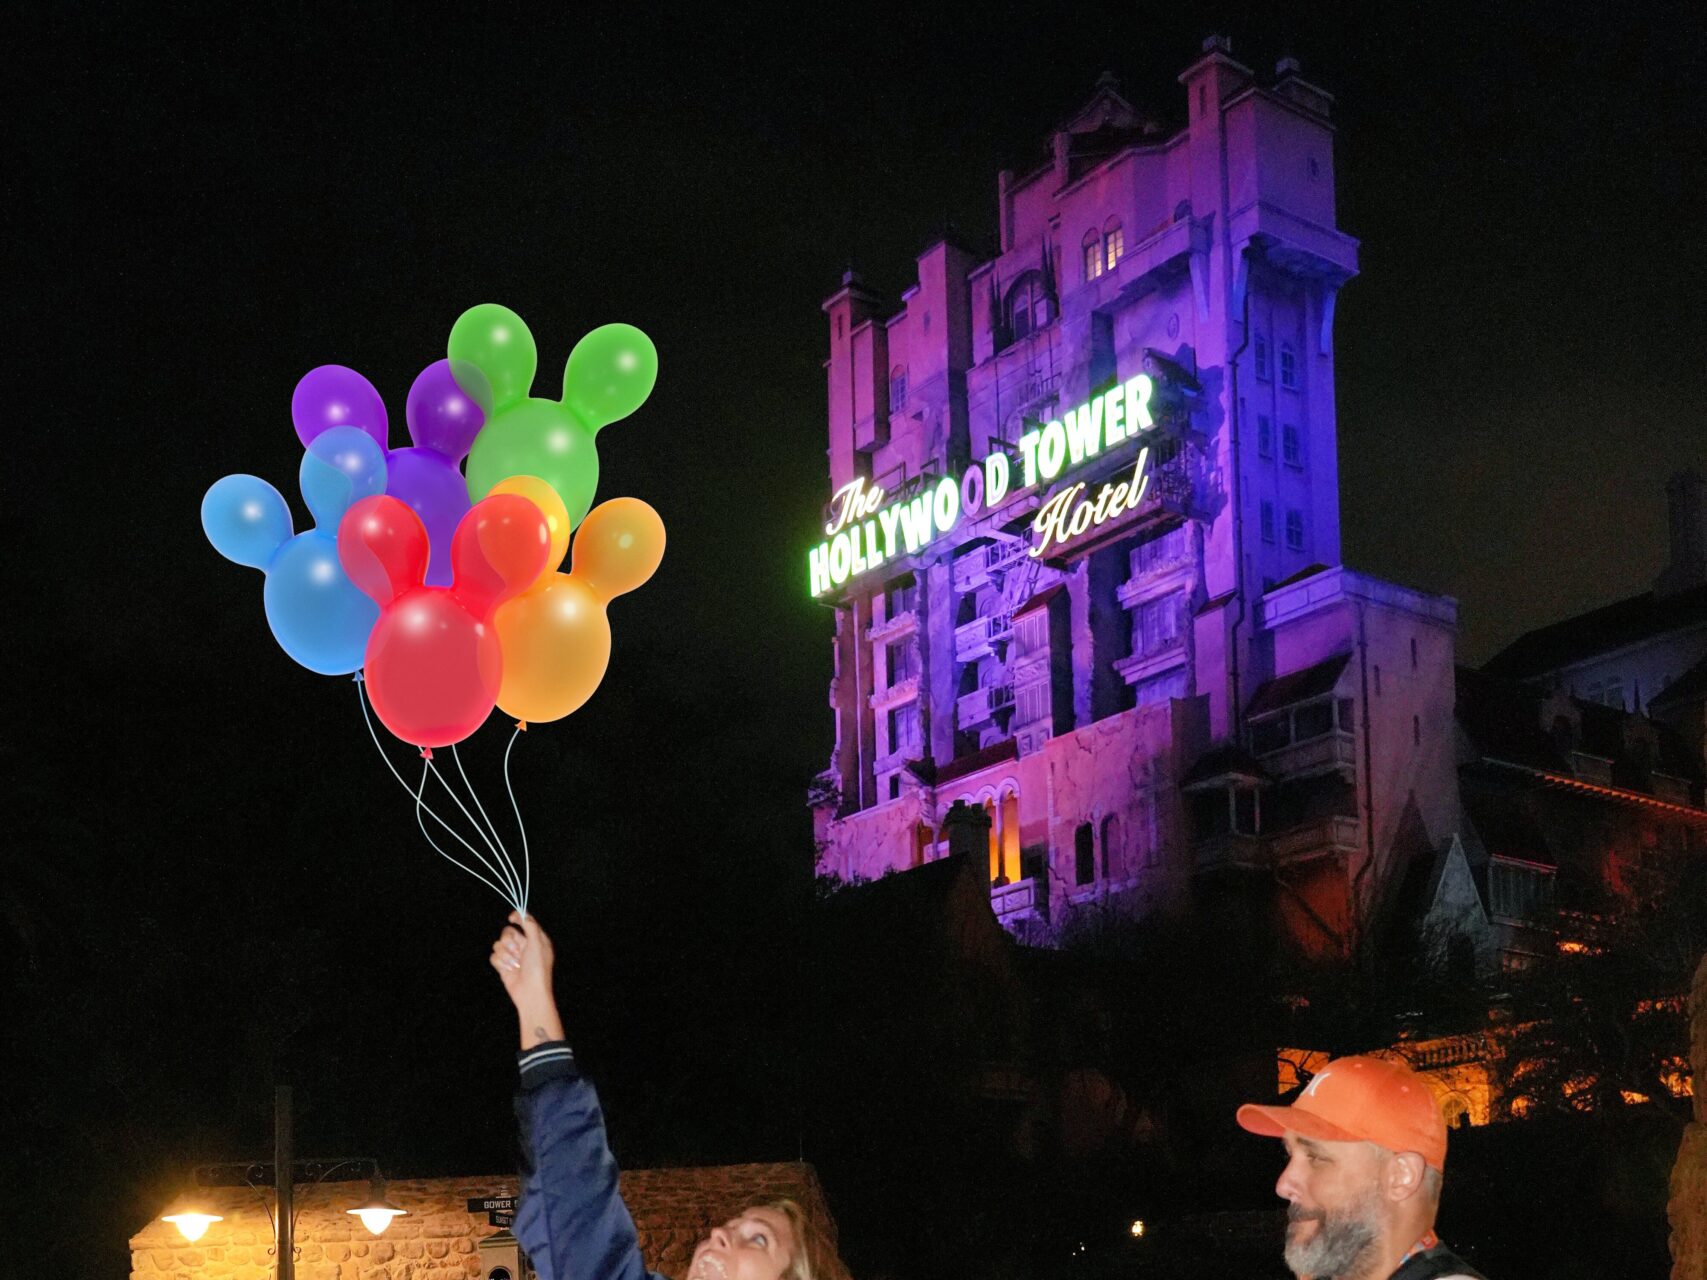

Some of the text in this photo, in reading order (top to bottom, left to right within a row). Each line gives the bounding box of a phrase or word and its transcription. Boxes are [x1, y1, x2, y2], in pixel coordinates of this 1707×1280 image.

[808, 374, 1155, 598] HOLLYWOOD TOWER
[826, 476, 884, 536] The
[1029, 447, 1149, 558] Hotel
[483, 1200, 512, 1209] GOWER
